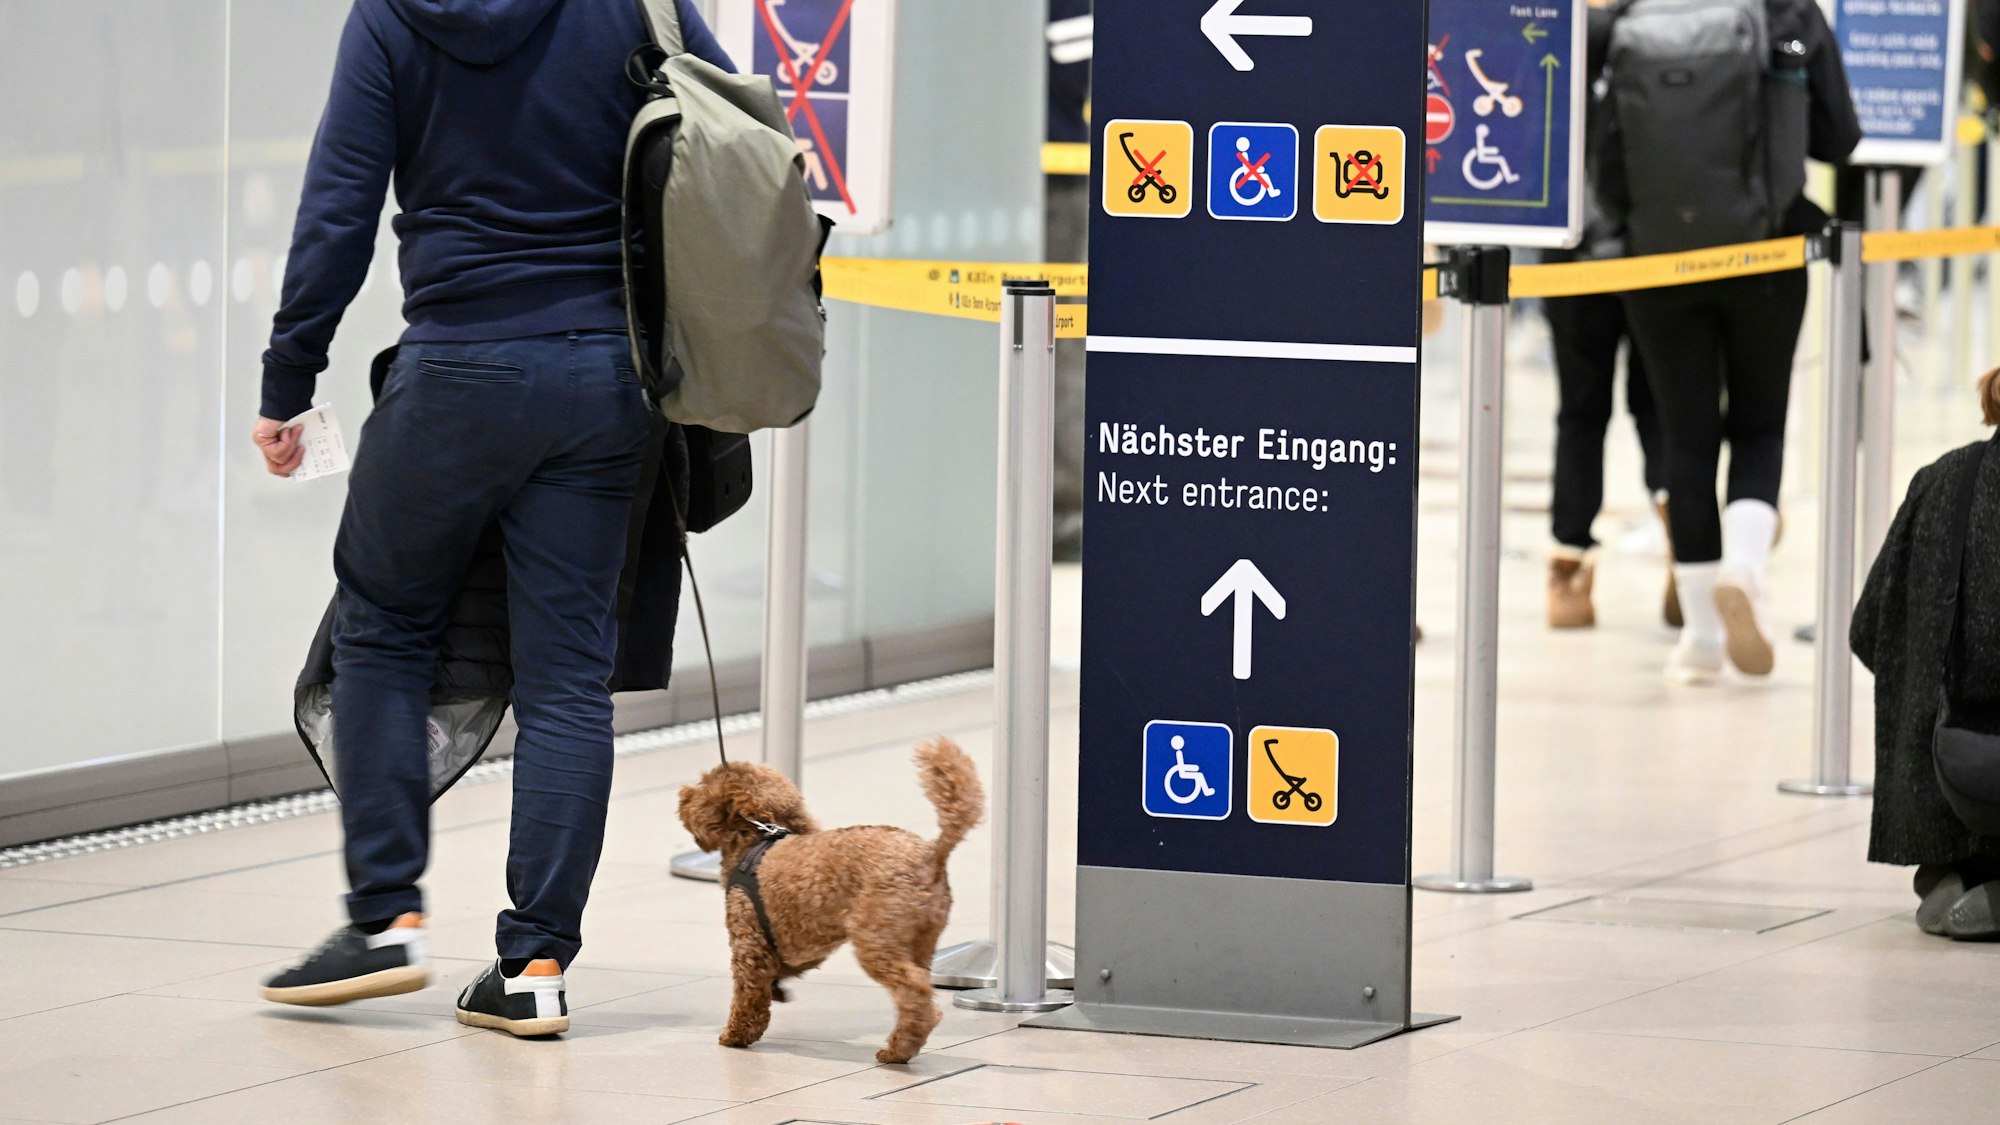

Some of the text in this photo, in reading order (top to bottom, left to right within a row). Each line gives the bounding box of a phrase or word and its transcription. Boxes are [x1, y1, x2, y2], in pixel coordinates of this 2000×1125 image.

[1510, 5, 1558, 18] Fast Lane
[1056, 314, 1074, 331] irport
[1100, 422, 1396, 472] Nächster Eingang:
[1099, 472, 1328, 511] Next entrance:
